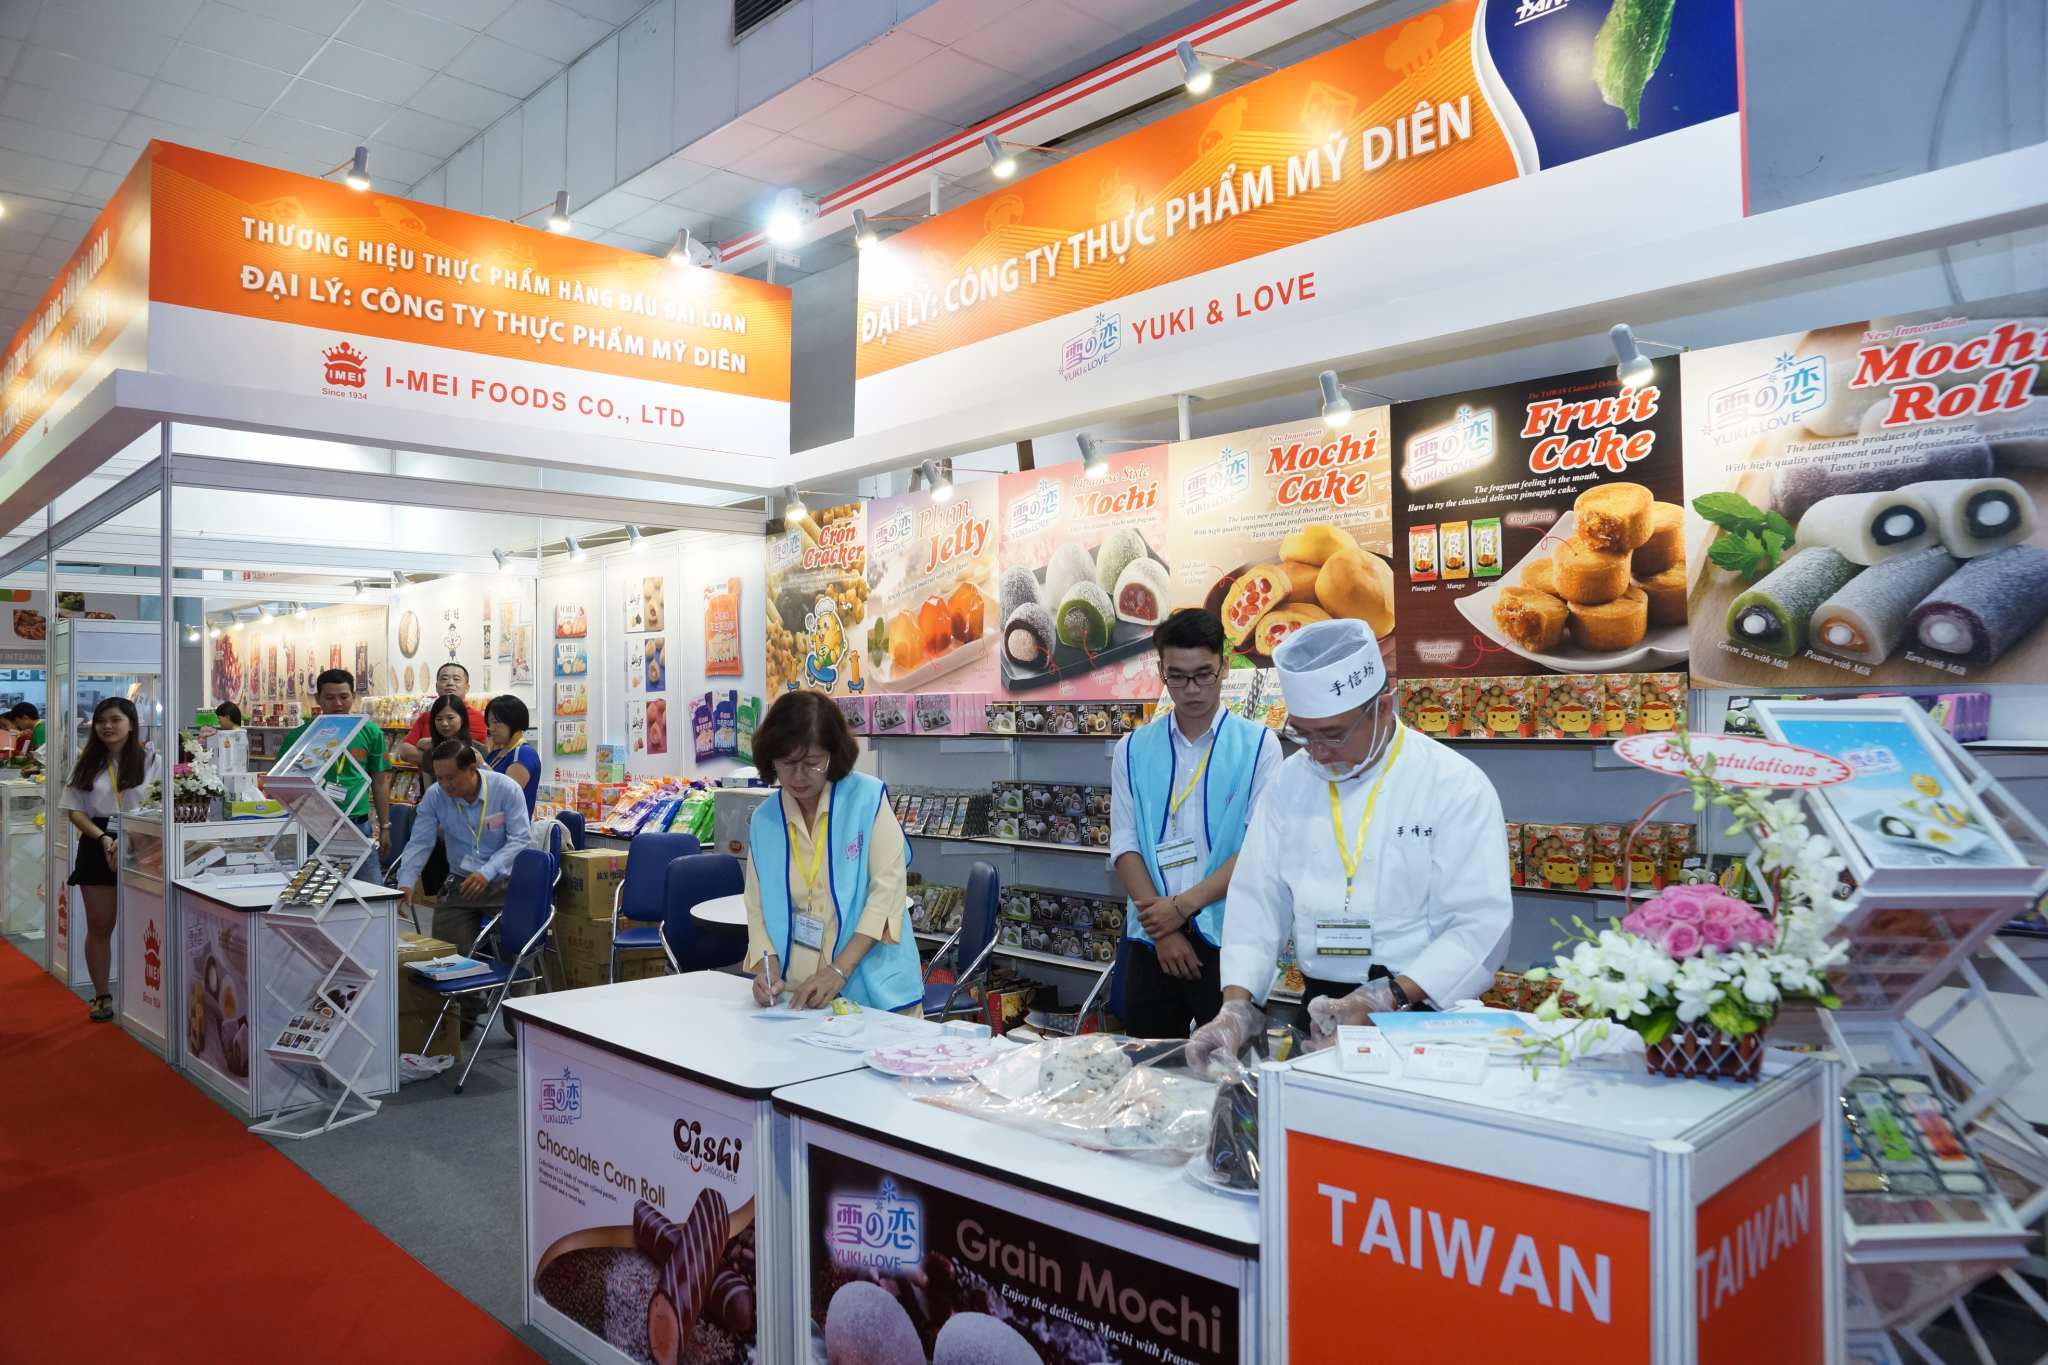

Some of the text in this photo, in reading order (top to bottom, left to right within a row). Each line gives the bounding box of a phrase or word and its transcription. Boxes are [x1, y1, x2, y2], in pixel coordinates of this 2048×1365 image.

[861, 302, 900, 345] ĐẠI
[944, 258, 1019, 313] CÔNG
[1025, 240, 1062, 284] TY
[1067, 205, 1156, 265] THỰC
[1165, 163, 1275, 238] PHẨM
[1286, 129, 1348, 198] MỸ
[1362, 95, 1472, 172] DIÊN
[241, 216, 348, 258] THƯƠNG
[358, 240, 414, 272] HIỆU
[422, 252, 481, 285] THỰC
[491, 266, 550, 296] PHẨM
[559, 280, 612, 309] HÀNG
[702, 310, 746, 335] LOAN
[240, 265, 746, 374] ĐẠI LÝ: CÔNG TY THỰC PHẨM MỸ DIÊN
[1131, 272, 1316, 345] YUKI & LOVE
[1894, 317, 1968, 337] Innovation
[1065, 321, 1118, 370] 雪の恋
[1850, 324, 2048, 387] Moch
[321, 387, 368, 400] Since 1934
[328, 369, 363, 383] IMEI
[385, 366, 685, 428] I-MEI FOODS CO., LTD
[1524, 388, 1657, 436] Fruit
[1712, 366, 1822, 429] 雪の恋
[1884, 368, 2032, 426] Roll
[1265, 429, 1378, 475] Mochi
[1531, 431, 1654, 471] Cake
[1786, 423, 1976, 454] The latest new product of this year
[1724, 463, 1746, 472] With
[1750, 460, 1772, 470] high
[1774, 455, 1810, 468] quality
[1812, 449, 1869, 463] equipment
[1870, 446, 1893, 455] and
[1830, 463, 1856, 473] Tasty
[1859, 461, 1870, 469] in
[1872, 459, 1898, 469] your
[1073, 482, 1157, 516] Mochi
[1277, 469, 1367, 505] Cake
[1408, 503, 1426, 512] Have
[1434, 502, 1445, 511] try
[1446, 499, 1457, 508] the
[1458, 496, 1488, 506] classical
[1489, 493, 1519, 503] delicacy
[1519, 488, 1557, 501] pineapple
[1557, 485, 1578, 495] cake.
[1474, 472, 1600, 494] The fragrant feeling in the mouth,
[1270, 508, 1294, 520] product
[1274, 518, 1287, 526] and
[803, 544, 864, 569] Cracker
[927, 518, 990, 573] Jelly
[1717, 640, 1789, 669] Green Tea with Milk
[1804, 649, 1872, 676] Peanut with Milk
[1904, 651, 1967, 676] Taro with Milk
[543, 1083, 579, 1111] 雪の恋
[674, 1118, 742, 1173] Oishi
[537, 1129, 600, 1176] Chocolate
[603, 1161, 637, 1194] Corn
[640, 1177, 665, 1209] Roll
[703, 1163, 737, 1184] CHOCOLATE
[836, 1202, 917, 1249] 雪の恋
[834, 1248, 901, 1270] YUKI&LOVE
[1318, 1182, 1611, 1325] TAIWAN
[1697, 1175, 1810, 1322] TAIWAN
[956, 1218, 1222, 1354] Grain Mochi
[1001, 1283, 1160, 1358] Enjoy the delicious Mochi with
